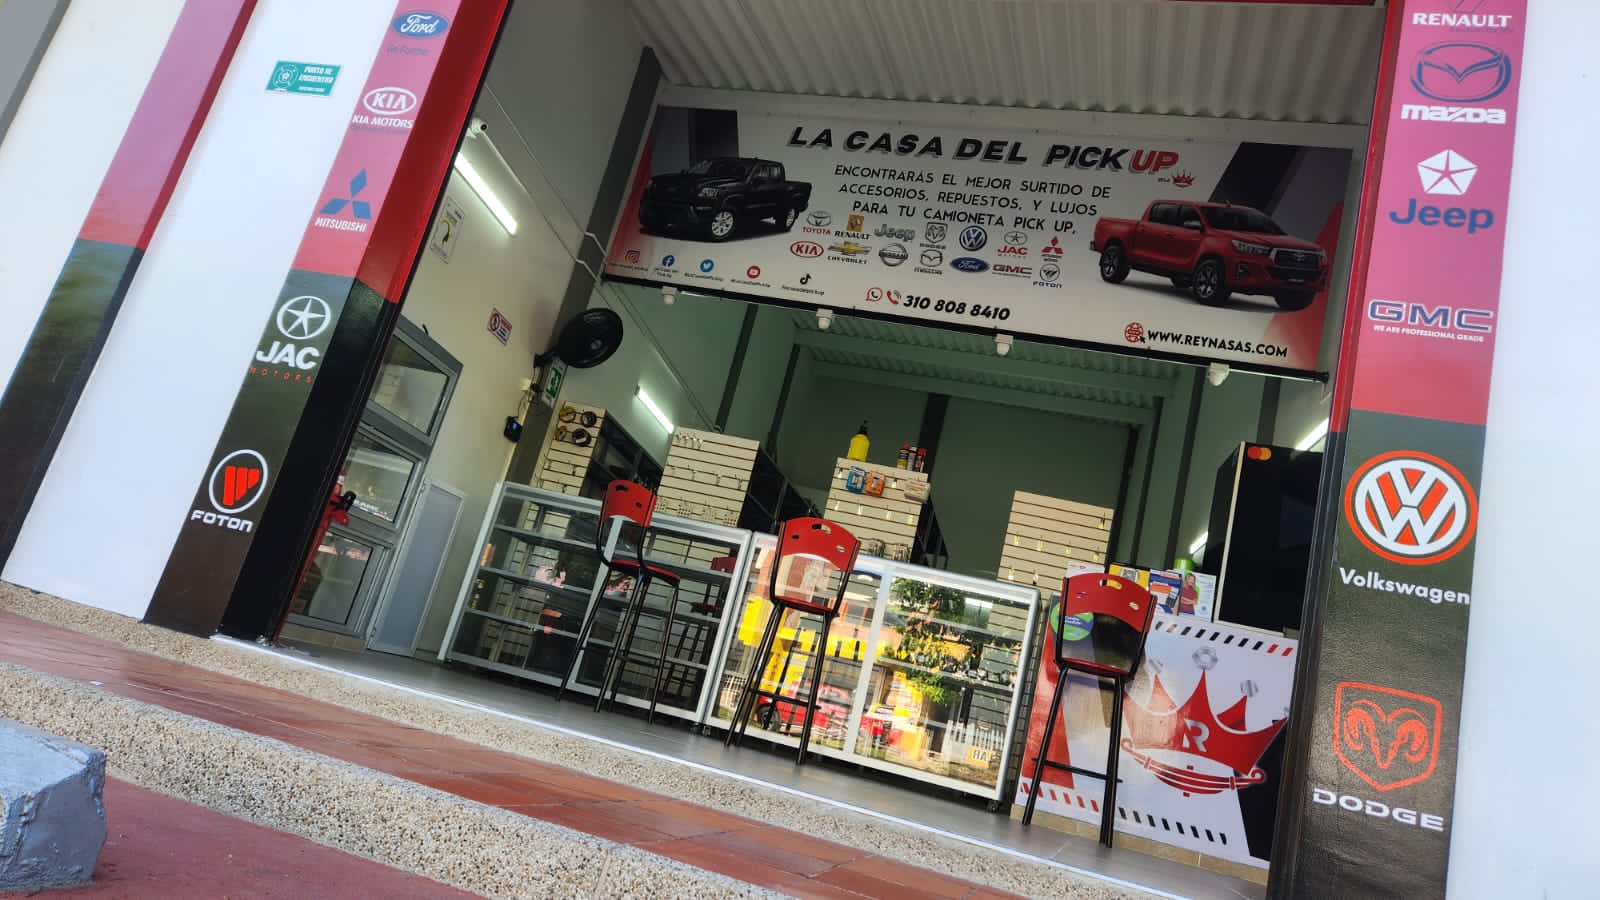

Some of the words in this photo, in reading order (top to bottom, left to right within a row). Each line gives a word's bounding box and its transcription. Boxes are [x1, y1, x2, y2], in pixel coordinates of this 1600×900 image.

[400, 14, 439, 33] Ford
[1412, 12, 1512, 28] RENAULT
[372, 93, 407, 110] KIA
[352, 115, 369, 125] KIA
[370, 116, 415, 129] MOTORS
[787, 126, 833, 149] LA
[844, 130, 943, 157] CASA
[953, 138, 1027, 163] DEL
[834, 164, 934, 184] ENCONTRARÁS
[942, 174, 958, 186] EL
[965, 176, 1011, 191] MEJOR
[1019, 180, 1083, 196] SURTIDO
[1091, 185, 1111, 198] DE
[838, 184, 929, 201] ACCESORIOS,
[937, 191, 1022, 210] REPUESTOS,
[1033, 200, 1042, 211] Y
[1050, 201, 1097, 216] LUJOS
[314, 217, 367, 232] MITSUBISHI
[852, 200, 889, 215] PARA
[898, 205, 917, 217] TU
[923, 208, 1004, 227] CAMIONETA
[1013, 216, 1045, 231] PICK
[1054, 220, 1075, 234] UP,
[1388, 198, 1494, 234] Jeep
[802, 226, 831, 235] TOYOTA
[834, 230, 871, 240] RENAULT
[795, 244, 819, 256] KIA
[997, 245, 1028, 255] JAC
[992, 264, 1032, 275] GMC
[903, 295, 931, 309] 310
[934, 299, 967, 315] 808
[970, 304, 1010, 321] 8410
[1368, 300, 1493, 332] GMC
[1147, 330, 1288, 358] WWW.REYNASAS.COM
[1401, 328, 1455, 339] PROFESSIONAL
[256, 341, 320, 370] JAC
[190, 509, 253, 532] FOTON
[1339, 567, 1471, 606] Volkswagen
[1312, 788, 1444, 832] DODGE
